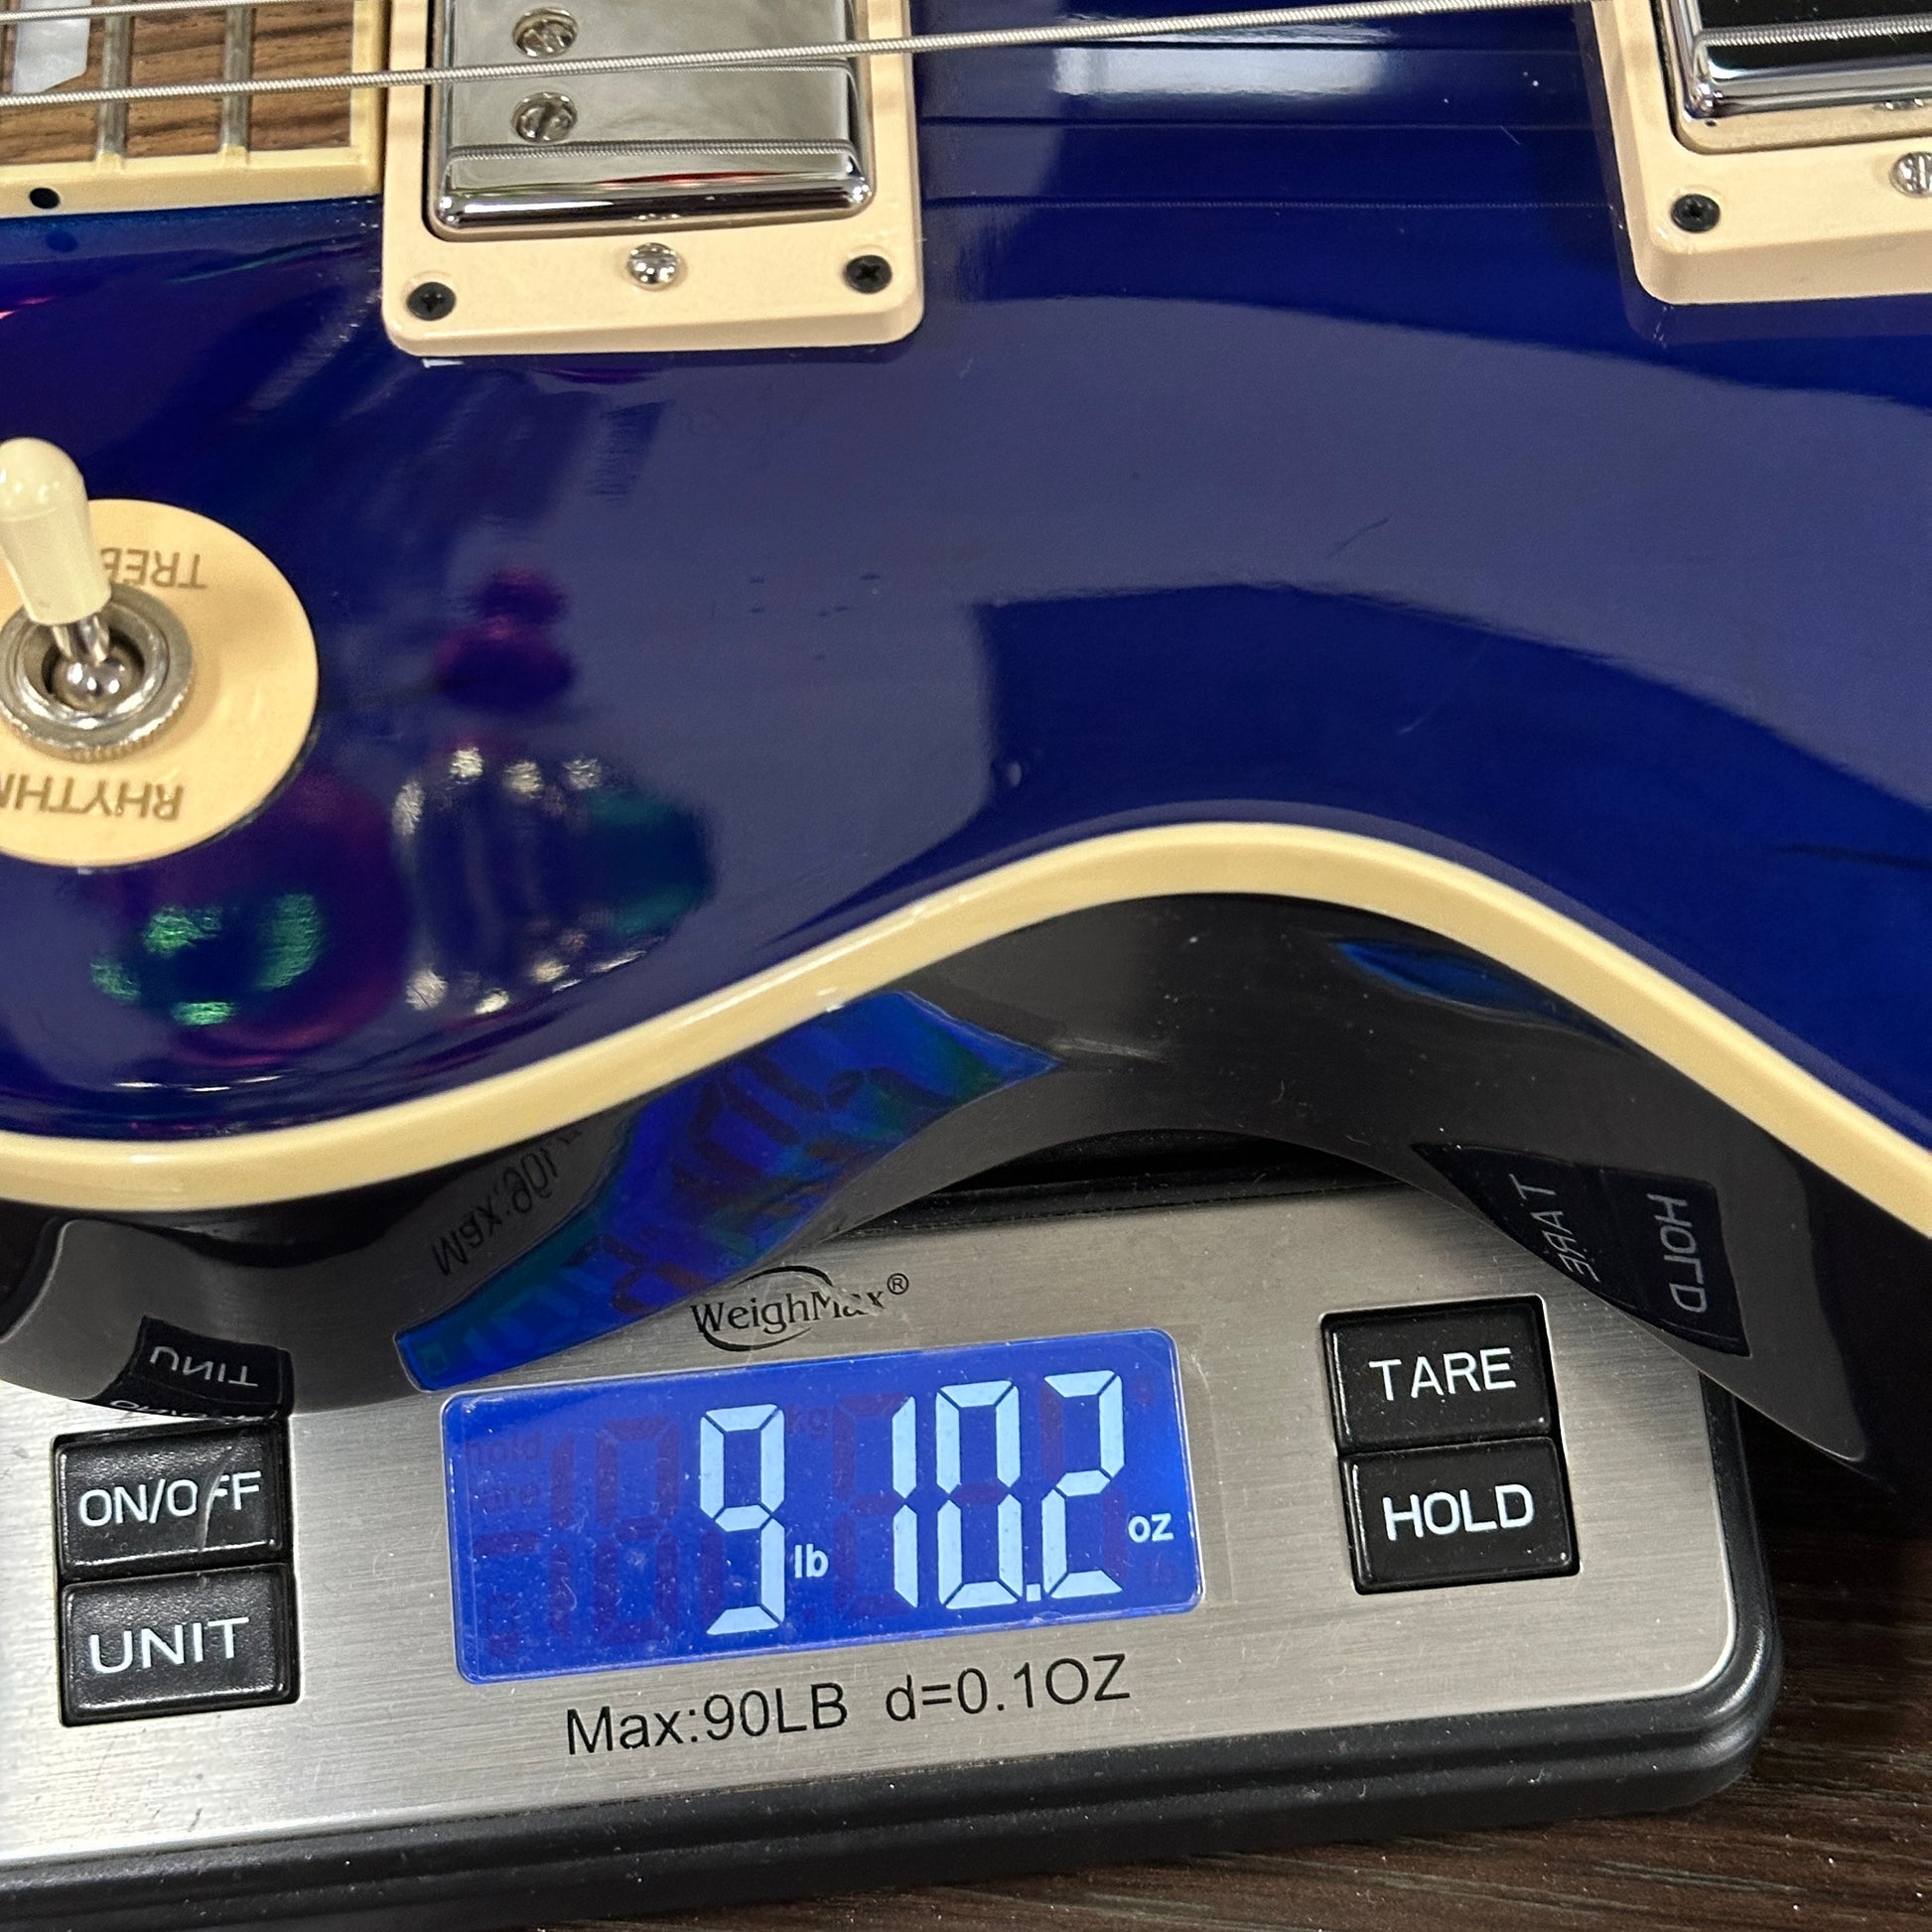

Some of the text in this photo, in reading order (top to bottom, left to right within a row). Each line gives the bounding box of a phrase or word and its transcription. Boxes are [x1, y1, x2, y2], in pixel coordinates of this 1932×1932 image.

[1369, 1347, 1517, 1401] TARE
[700, 1370, 1173, 1635] 9 lb 10.2 oz
[1382, 1484, 1535, 1541] HOLD
[89, 1617, 250, 1674] UNIT
[565, 1683, 848, 1754] Max:90LB
